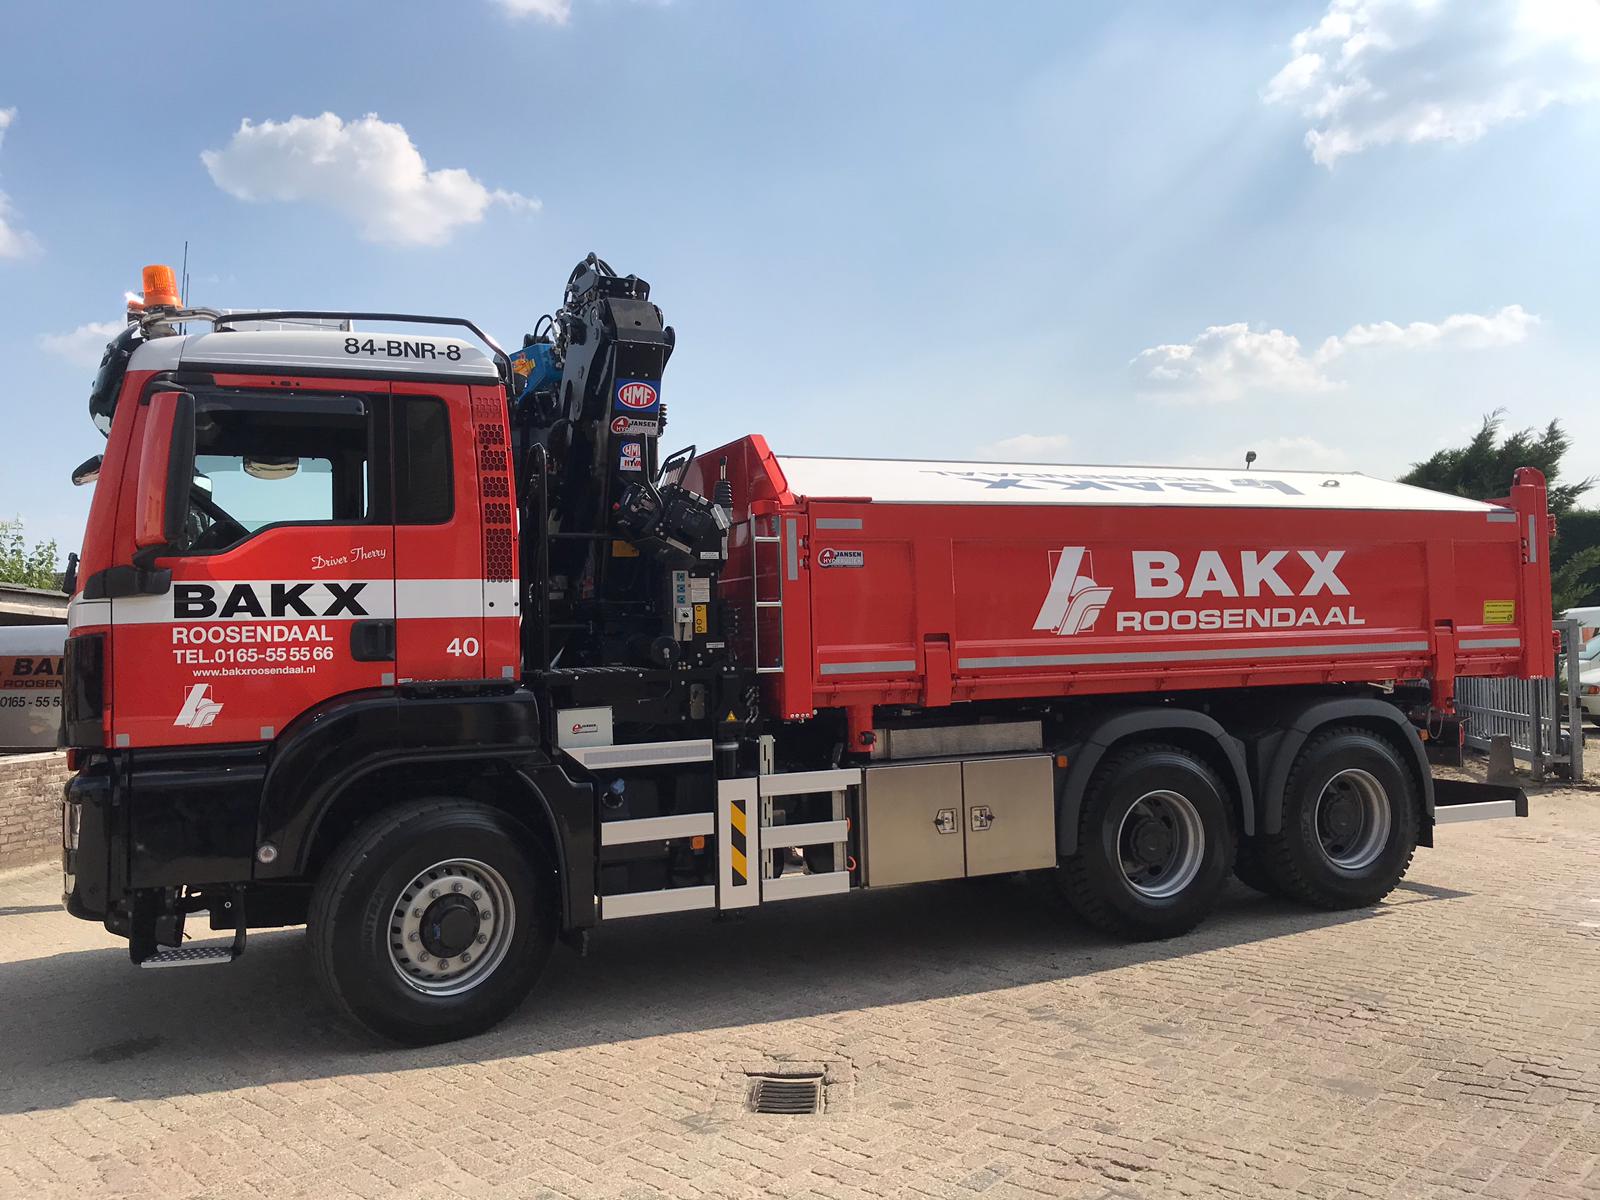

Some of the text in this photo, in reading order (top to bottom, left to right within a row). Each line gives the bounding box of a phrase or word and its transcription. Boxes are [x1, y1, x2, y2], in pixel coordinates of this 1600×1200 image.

[344, 337, 462, 361] 84-BNR-8
[622, 383, 652, 405] HMF
[958, 477, 1238, 494] BAKX
[311, 546, 387, 570] Driver Therry
[1131, 550, 1351, 599] BAKX
[173, 583, 369, 618] BAKX
[1116, 606, 1366, 632] ROOSENDAAL
[172, 625, 334, 644] ROOSENDAAL
[446, 637, 479, 657] 40
[192, 665, 316, 677] www.bakxroosendaal.nl
[35, 696, 50, 708] 55
